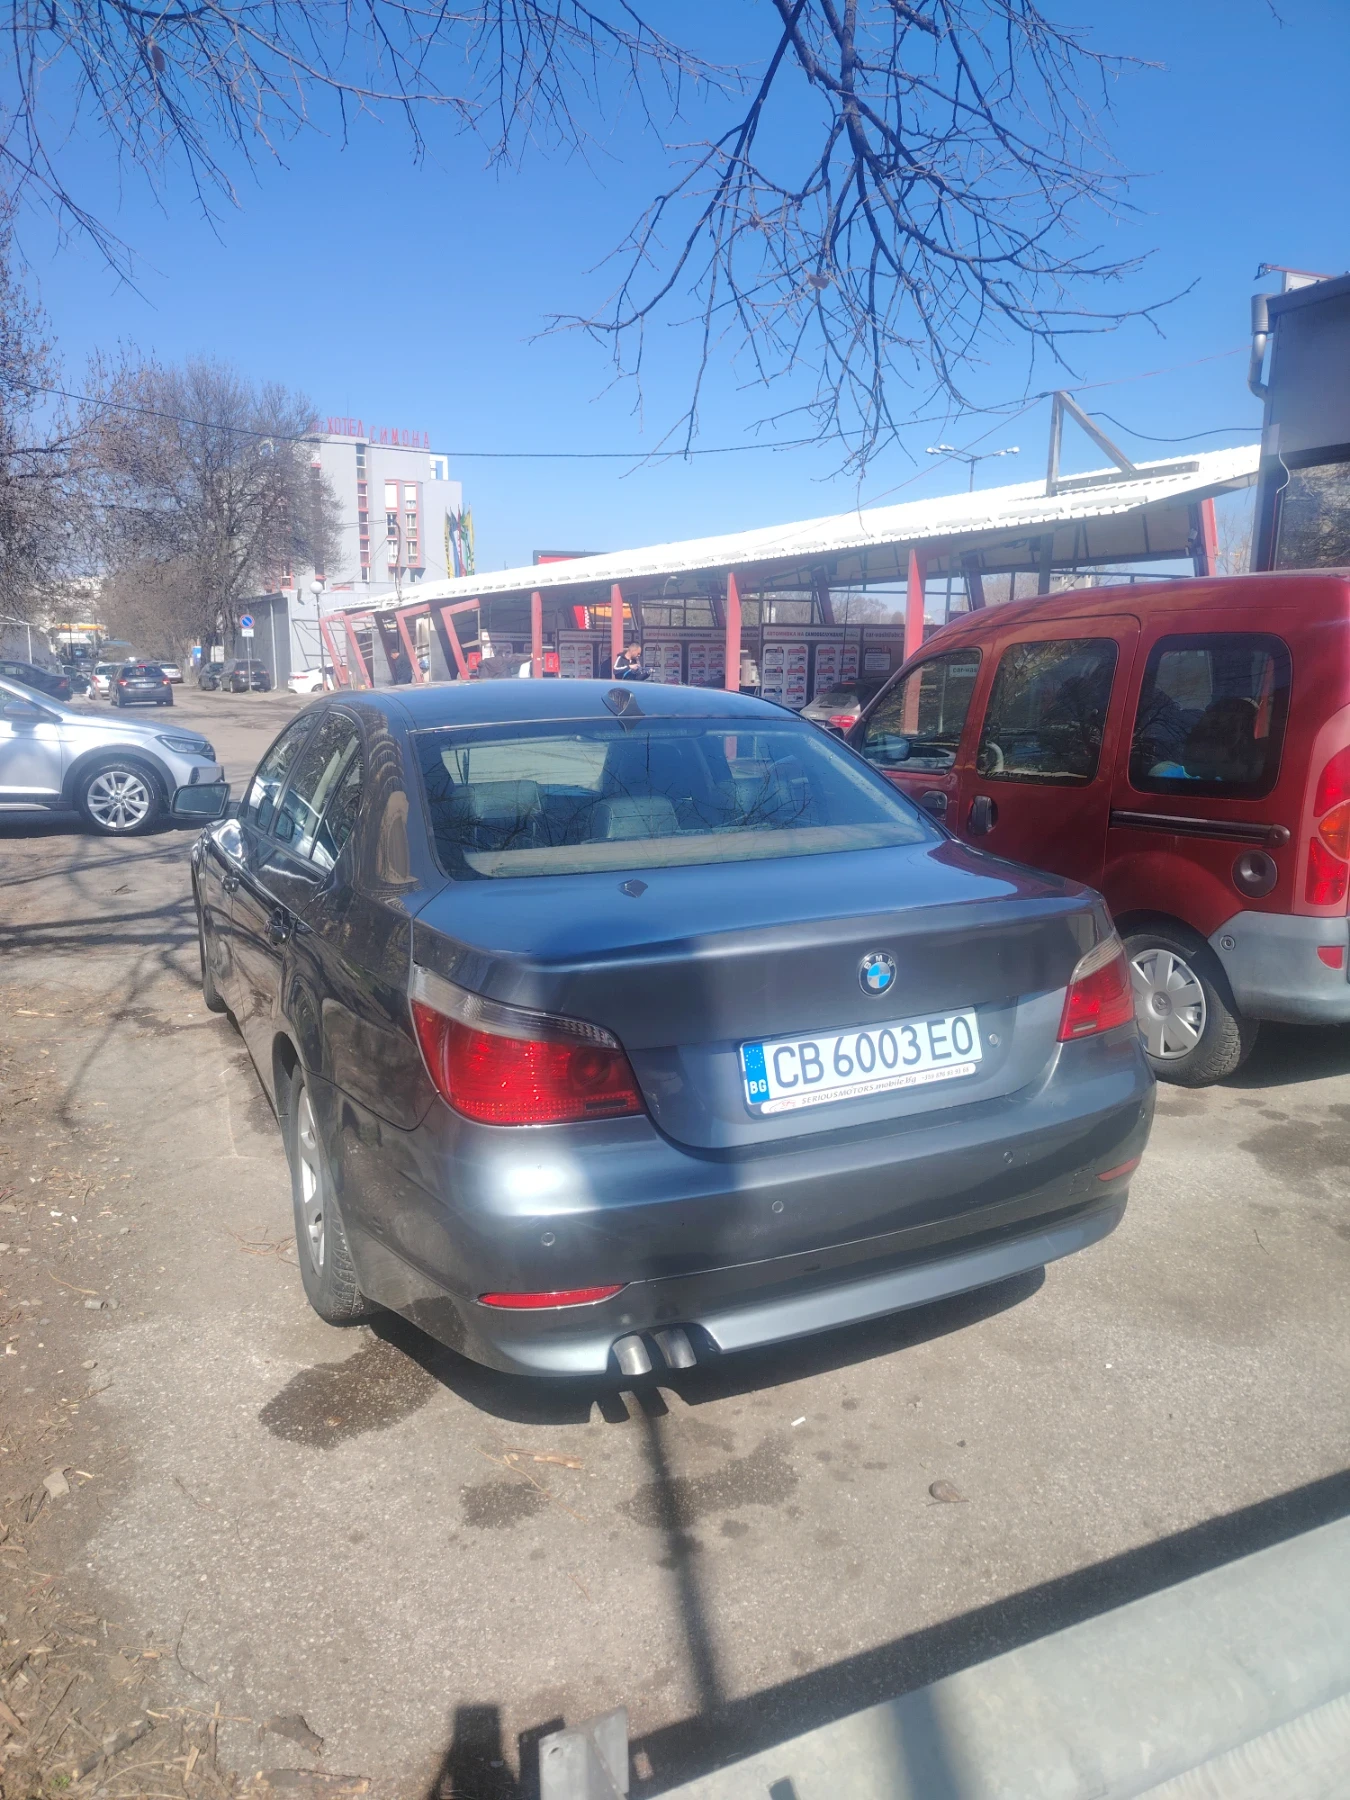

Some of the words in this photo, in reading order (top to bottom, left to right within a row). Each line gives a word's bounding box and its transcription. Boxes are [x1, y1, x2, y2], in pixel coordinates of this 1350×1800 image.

[327, 416, 364, 437] ХОТЕЛ
[369, 425, 431, 449] СИМОНА
[863, 954, 895, 970] BMW
[773, 1042, 825, 1089] CB
[833, 1025, 922, 1078] 6003
[749, 1078, 767, 1094] BG
